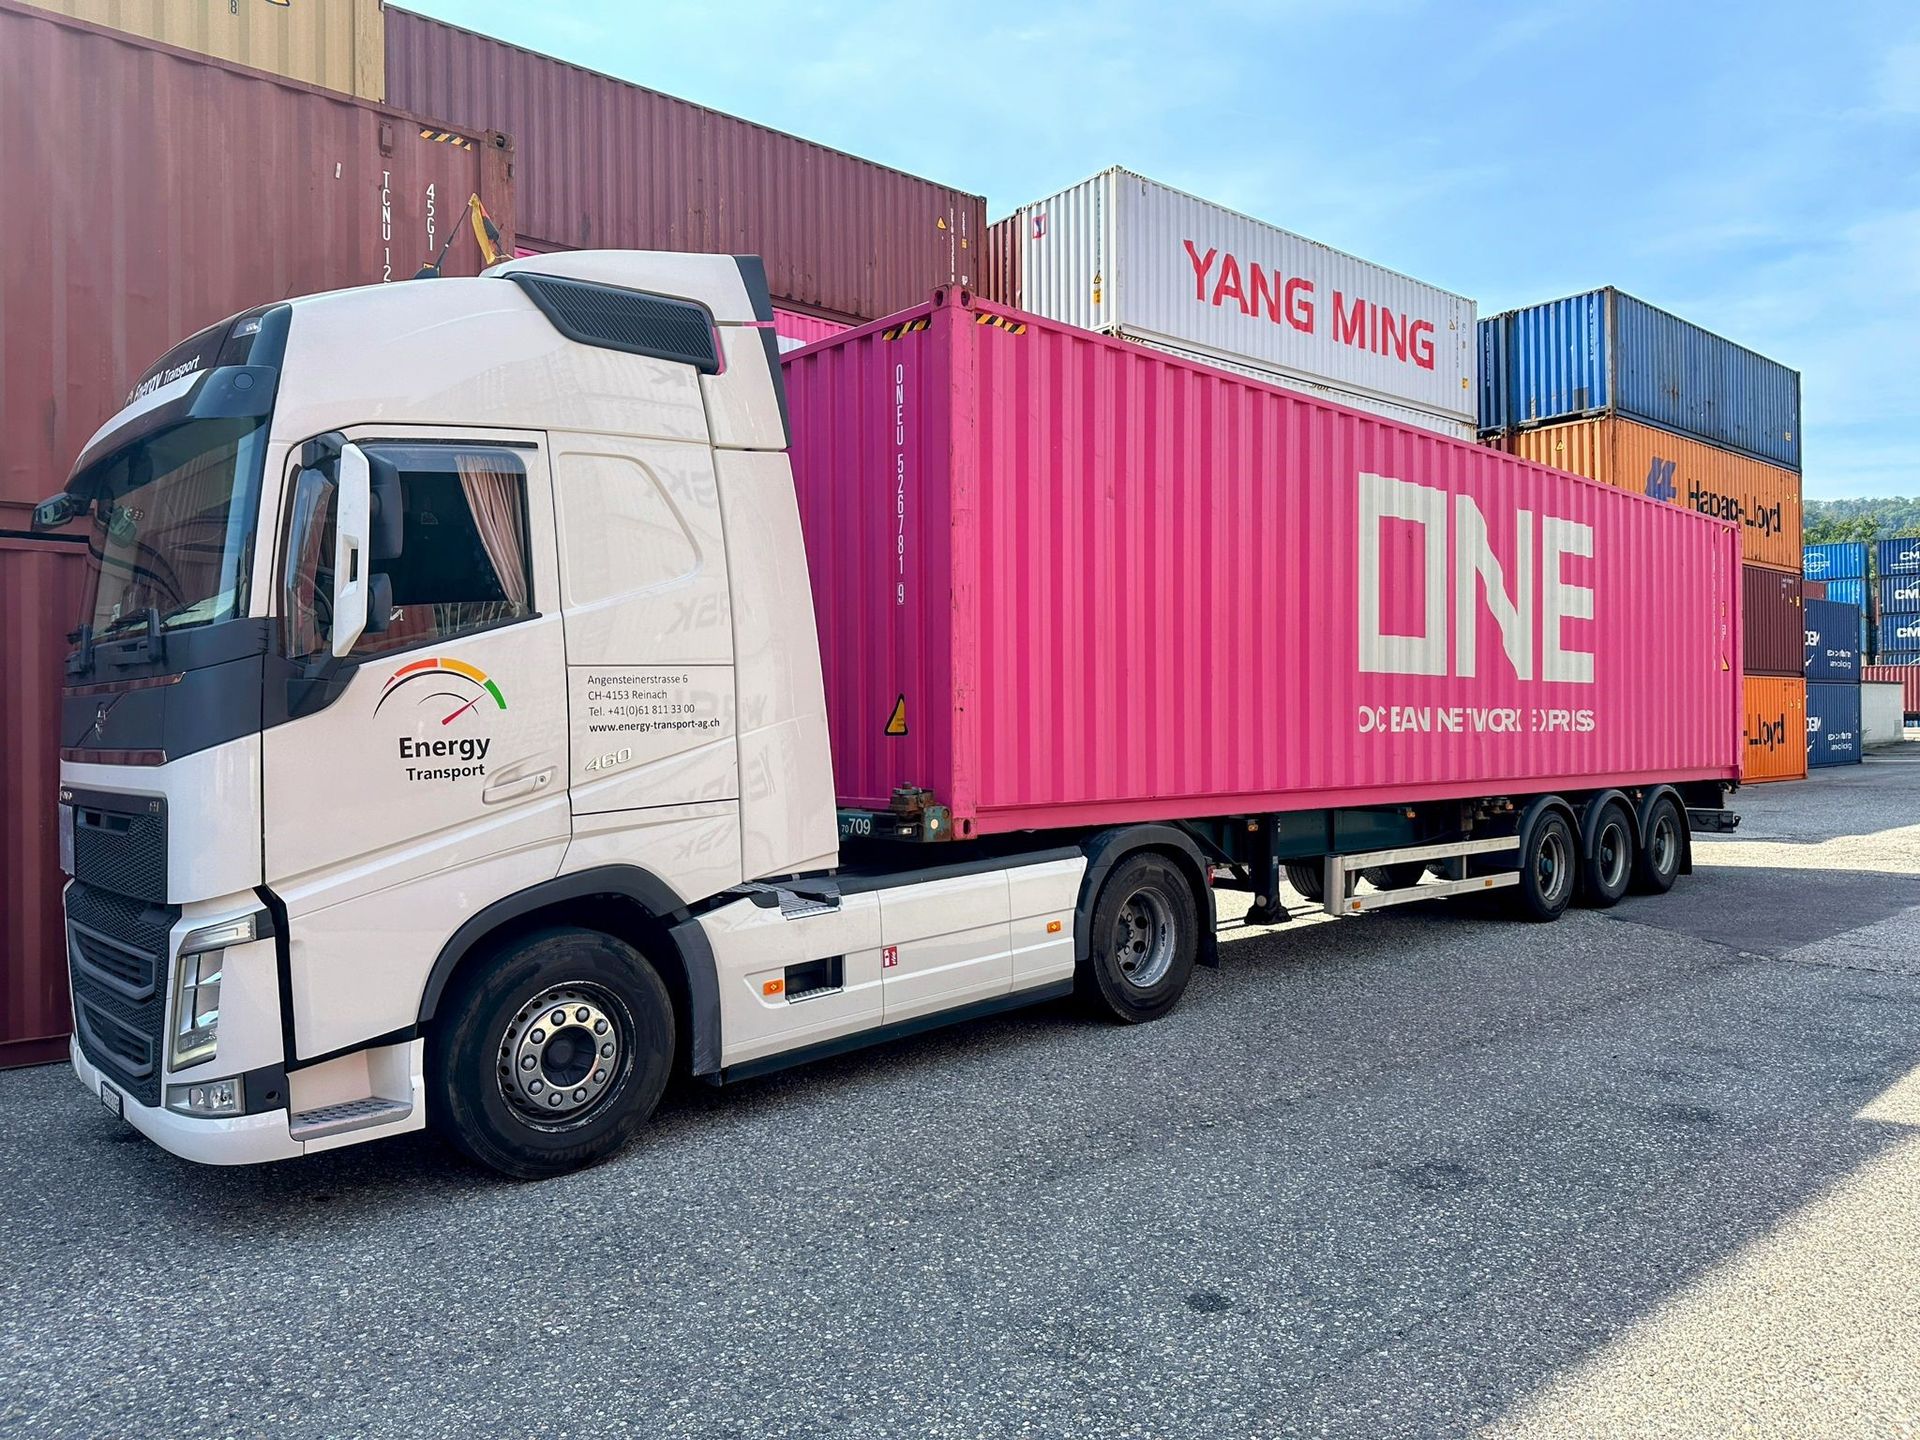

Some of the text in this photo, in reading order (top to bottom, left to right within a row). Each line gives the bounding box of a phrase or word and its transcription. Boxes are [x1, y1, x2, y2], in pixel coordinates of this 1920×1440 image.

[382, 170, 392, 283] TCNU 12
[426, 183, 435, 251] 45G1
[1182, 239, 1315, 335] YANG
[1332, 289, 1435, 371] MING
[163, 355, 200, 385] Transport
[895, 364, 904, 446] ONEU
[896, 453, 904, 575] 526781
[1358, 471, 1595, 684] ONE
[1894, 588, 1920, 600] CM
[587, 674, 689, 687] Angensteinerstrasse 6
[587, 689, 668, 701] CH-4153 Reinach
[588, 703, 695, 717] Tel. +41(0)61 811 33 00
[1359, 705, 1431, 733] OCEAN
[588, 718, 721, 733] www.energy-transport-ag.ch
[398, 737, 491, 762] Energy
[584, 747, 632, 772] 460
[405, 763, 486, 782] Transport
[849, 817, 871, 835] 709
